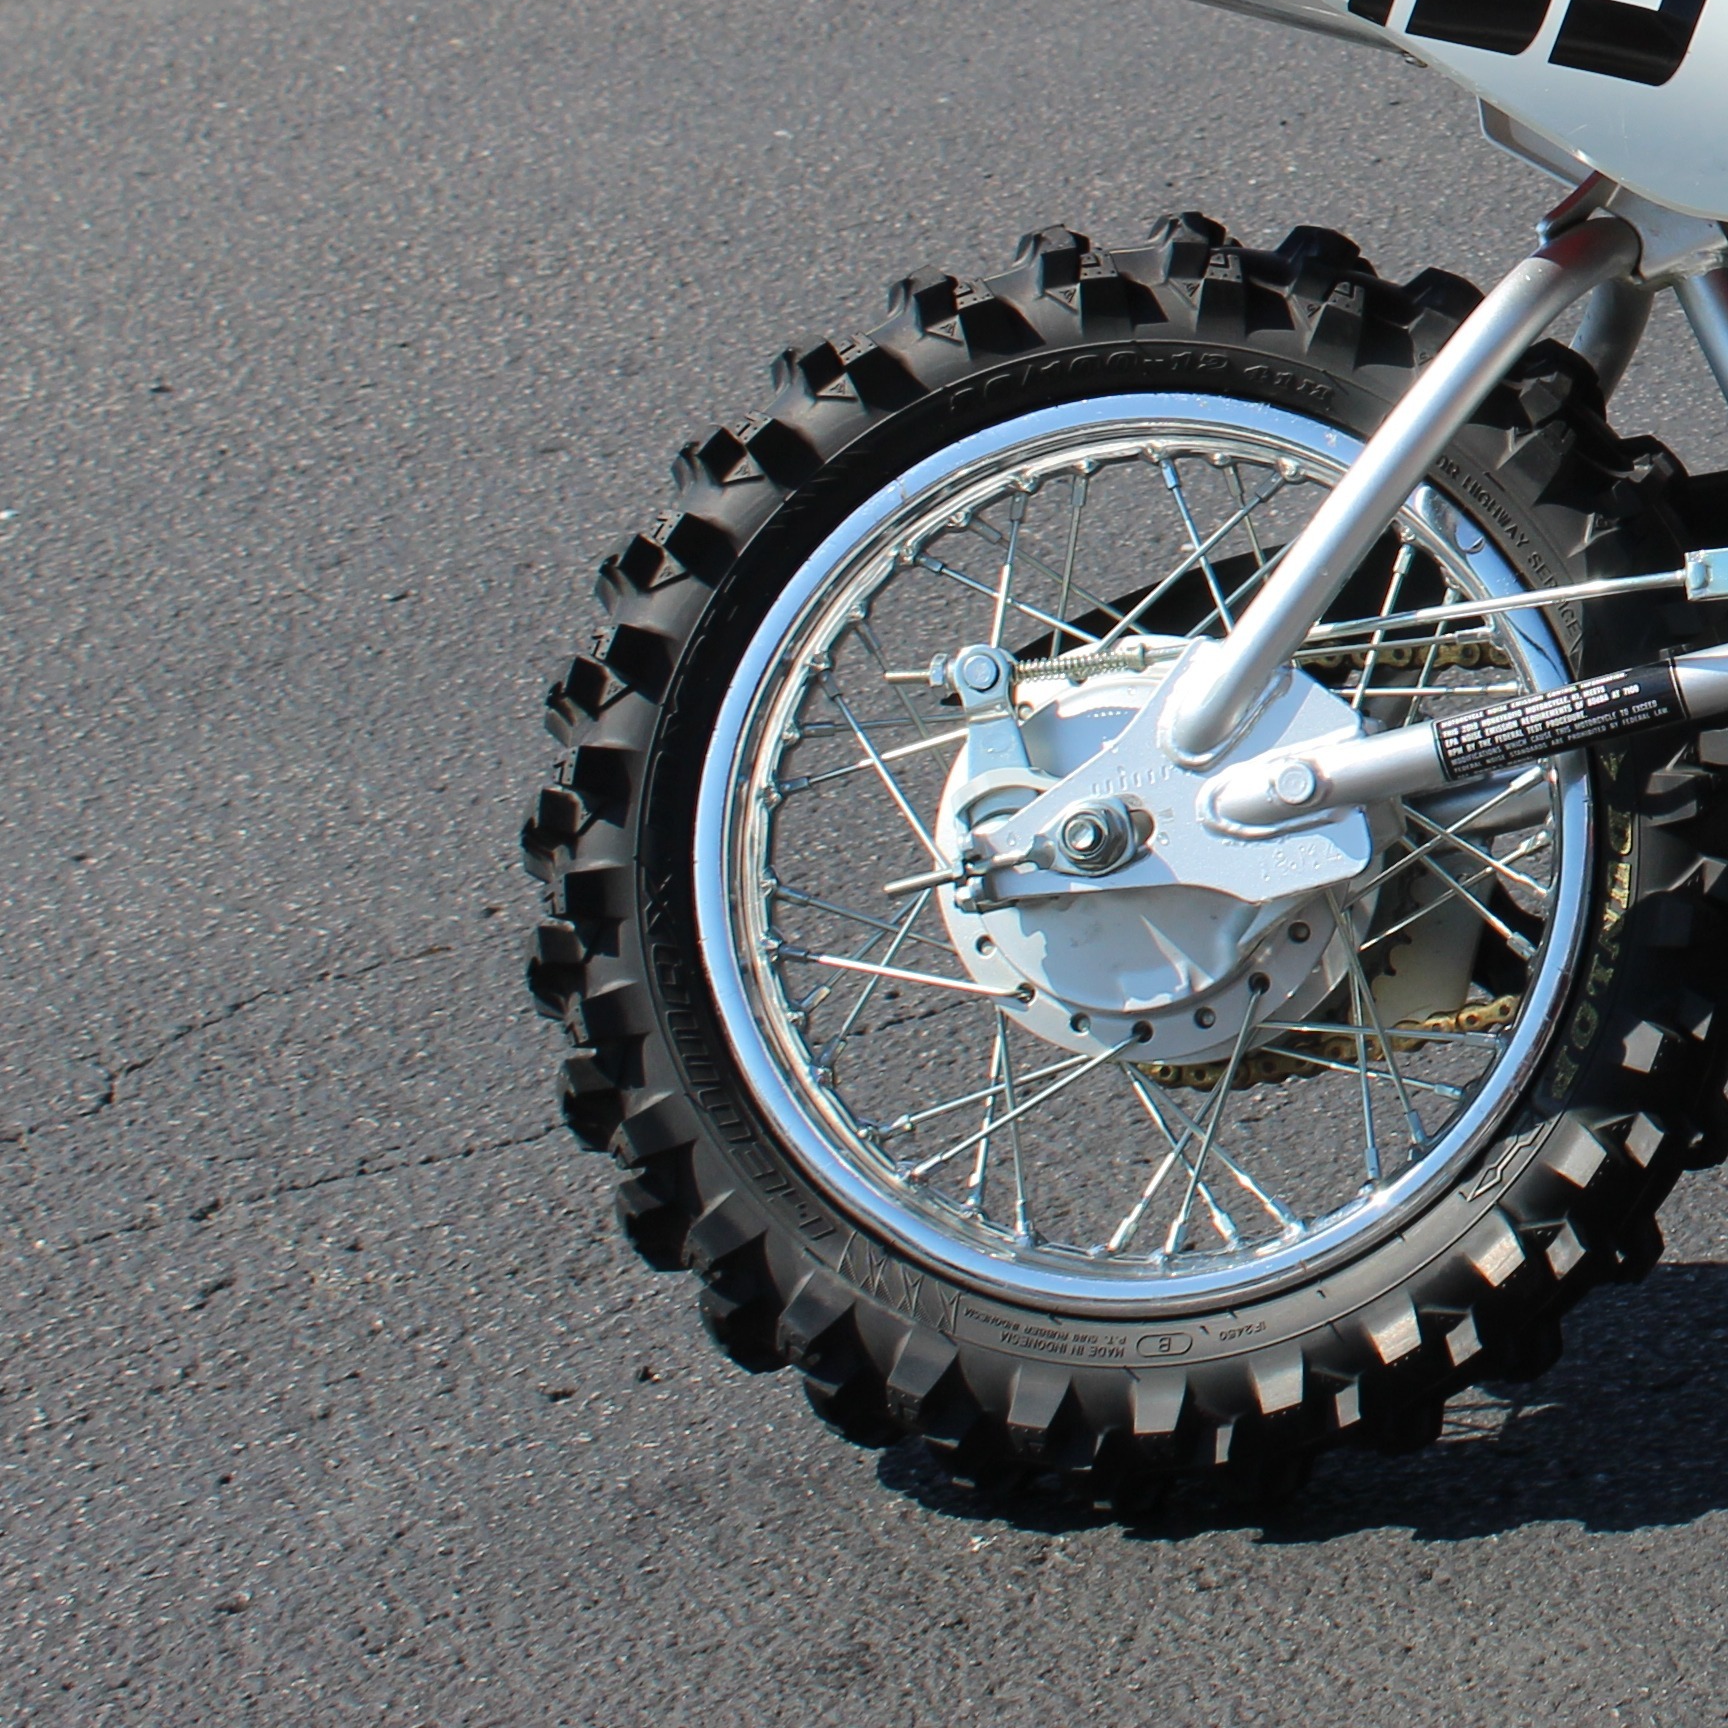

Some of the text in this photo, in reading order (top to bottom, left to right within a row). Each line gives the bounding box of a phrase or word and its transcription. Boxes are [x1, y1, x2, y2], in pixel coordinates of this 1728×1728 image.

[1461, 475, 1530, 548] HIGHWAY
[1528, 551, 1583, 637] SERICE
[1611, 690, 1620, 699] AT
[1466, 743, 1475, 752] BY
[1478, 738, 1492, 748] THE
[1495, 729, 1523, 743] FEDERAL
[1526, 723, 1542, 734] TEST
[1510, 743, 1548, 757] STANDARDS
[1568, 725, 1606, 740] PROHIBITED
[1623, 714, 1650, 725] FEDERAL
[1530, 732, 1552, 742] CAUSE
[1574, 712, 1616, 728] MOTORCYCLE
[1620, 708, 1629, 716] TO
[1632, 700, 1657, 712] EXCEED
[1001, 1332, 1126, 1358] MADE IN INDONESIA
